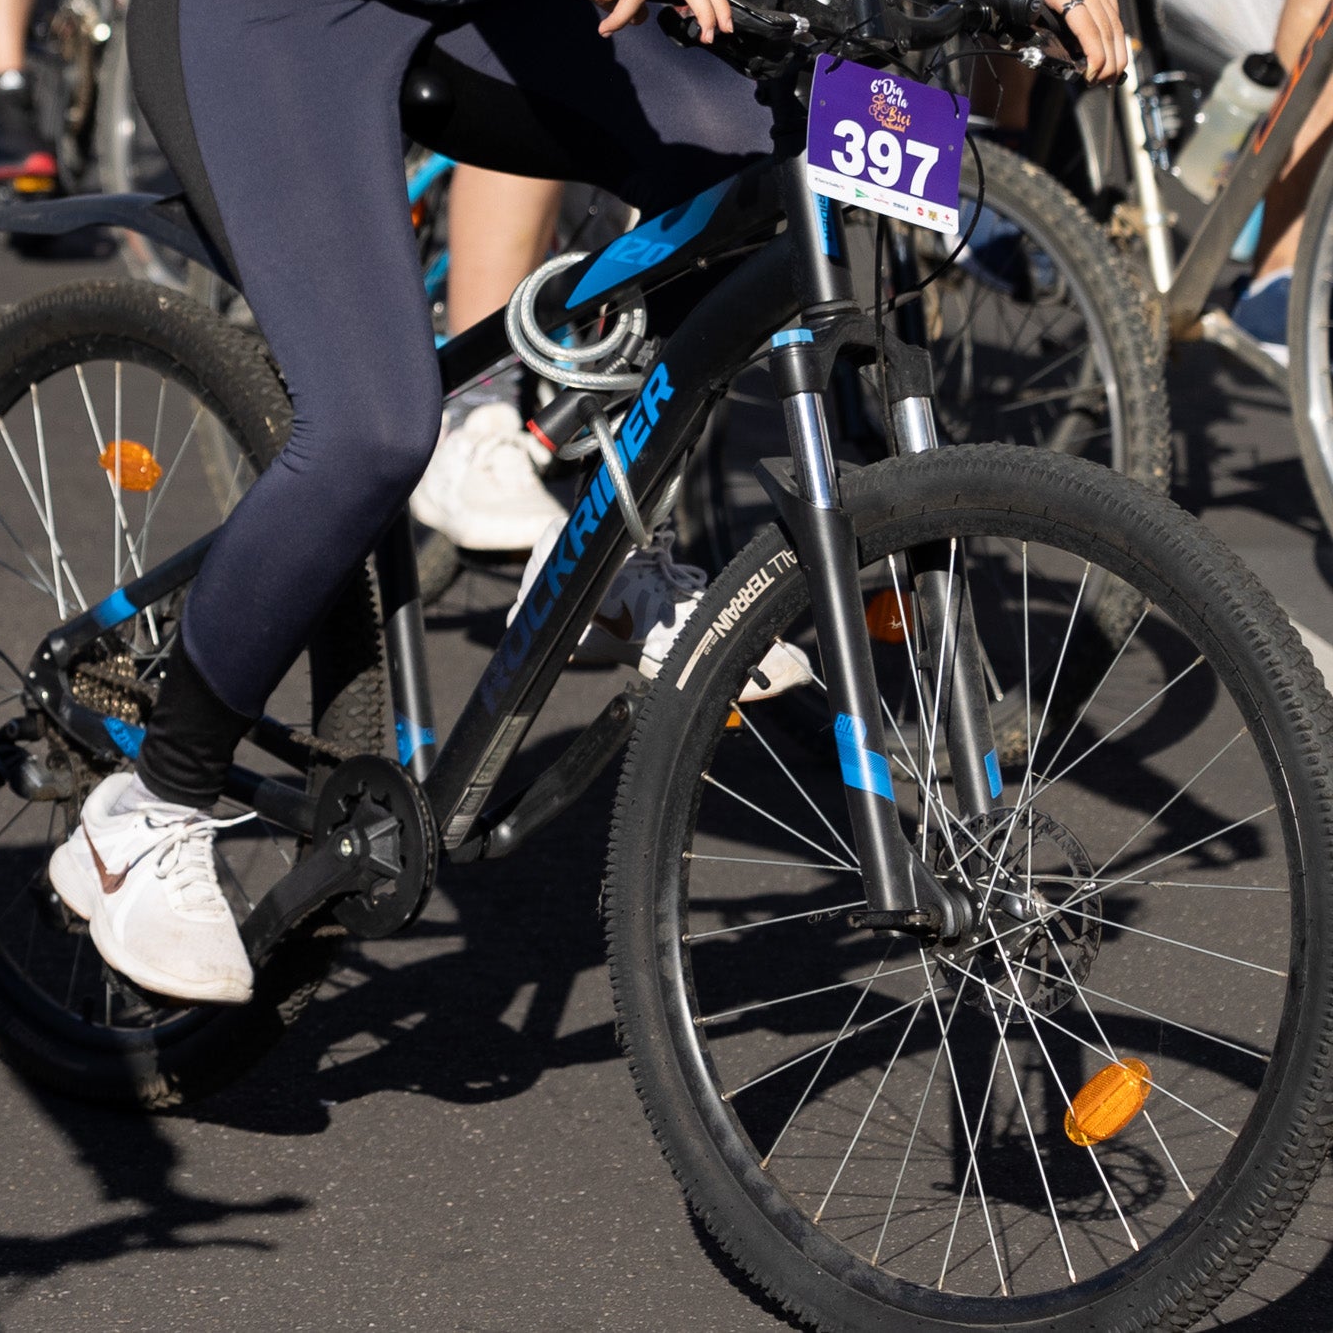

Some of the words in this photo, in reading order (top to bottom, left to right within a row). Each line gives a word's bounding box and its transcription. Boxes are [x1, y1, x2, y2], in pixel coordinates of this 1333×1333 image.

[886, 106, 911, 126] Bici
[831, 119, 940, 198] 397
[604, 236, 675, 267] 120
[476, 363, 676, 714] ROCKRIDER
[711, 567, 775, 638] TERRAIN
